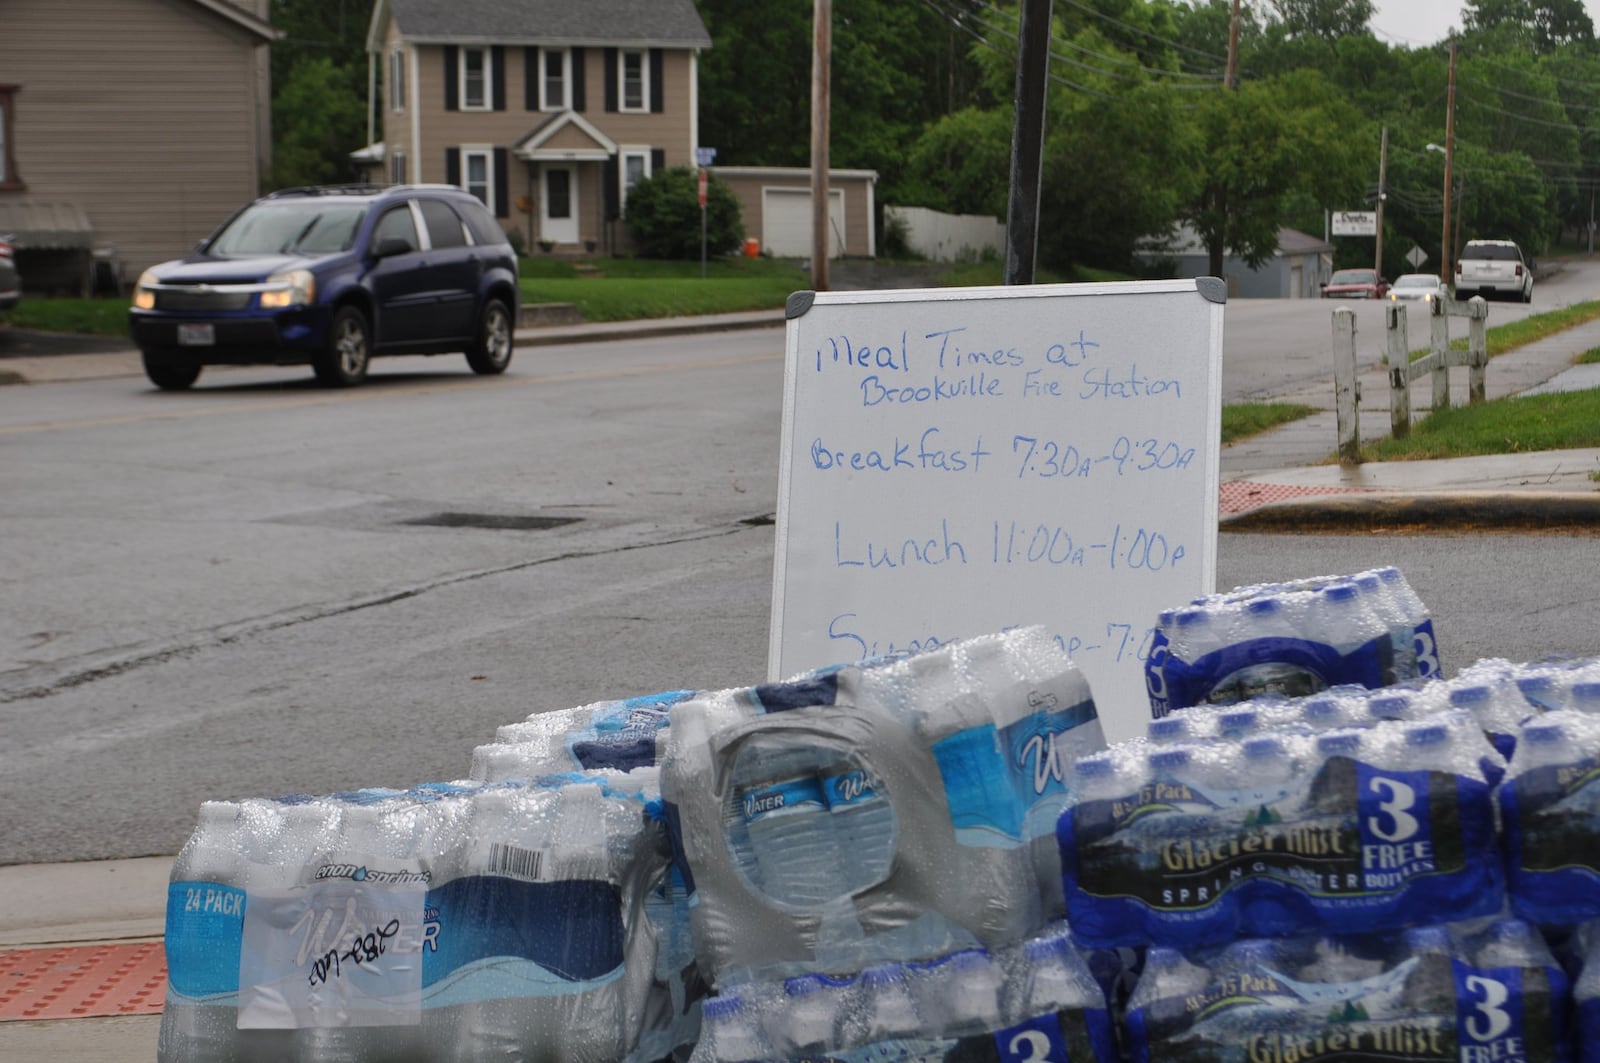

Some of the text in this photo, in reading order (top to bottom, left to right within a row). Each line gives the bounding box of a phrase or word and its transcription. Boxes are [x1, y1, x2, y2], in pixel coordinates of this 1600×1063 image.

[817, 327, 1100, 372] Meal Times at
[860, 362, 1182, 406] Brookville Fire Station
[811, 427, 992, 473] Breakfast
[834, 518, 967, 568] Lunch
[1155, 782, 1194, 801] Pack
[1368, 775, 1420, 843] 3
[1162, 826, 1345, 871] Glacier Mist
[1362, 840, 1436, 870] FREE
[314, 864, 357, 880] enon
[1162, 861, 1267, 904] SPRING
[1363, 860, 1436, 888] BOTTLES
[184, 887, 243, 917] 24 PACK
[1240, 972, 1280, 993] Pack
[1465, 973, 1512, 1042] 3
[1250, 1028, 1366, 1063] Glacier
